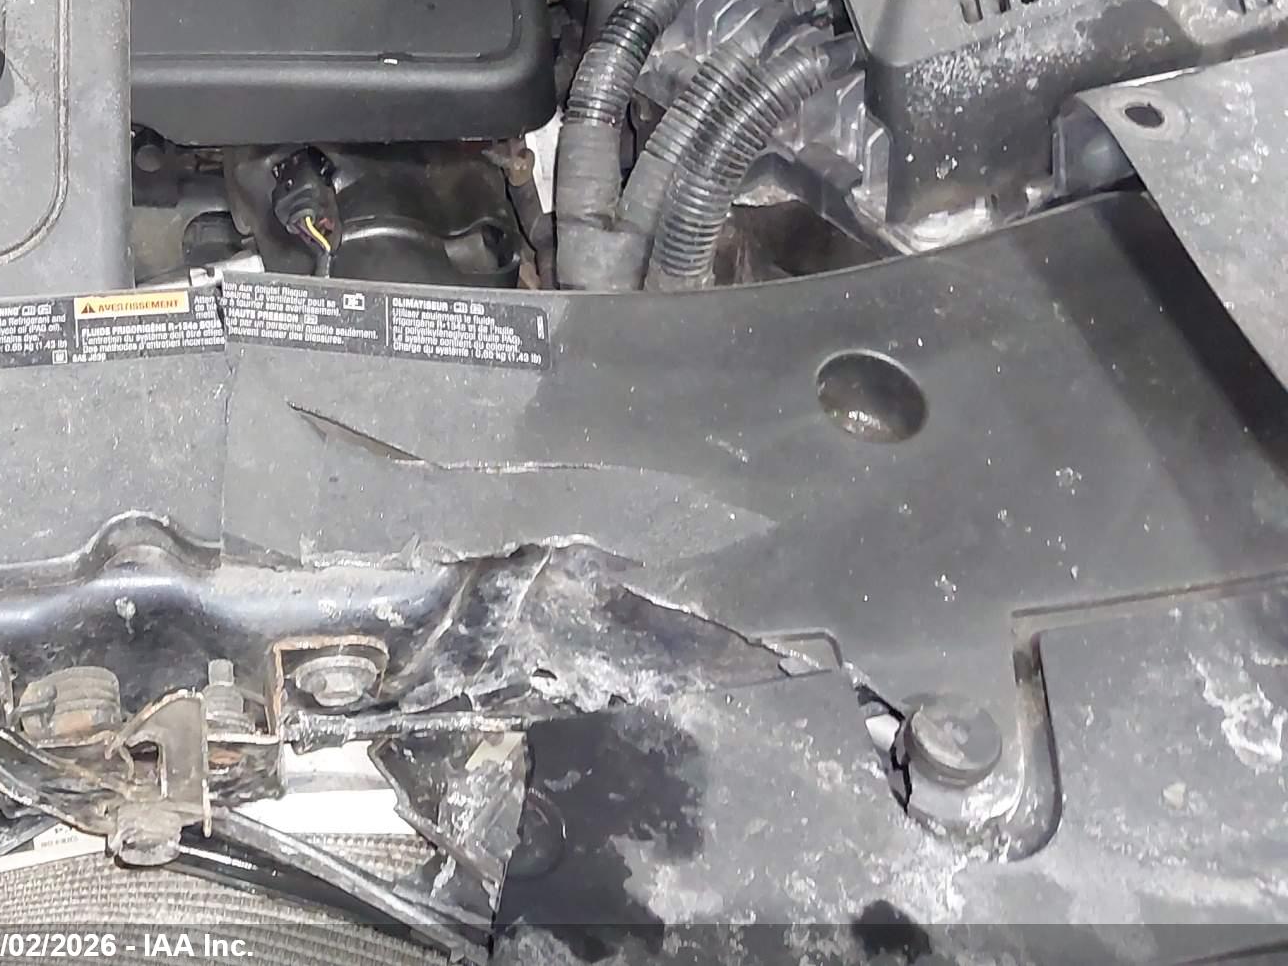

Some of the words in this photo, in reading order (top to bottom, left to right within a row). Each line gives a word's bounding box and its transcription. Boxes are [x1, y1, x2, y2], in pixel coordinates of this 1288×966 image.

[282, 289, 308, 299] Risque
[98, 299, 178, 313] AVERTISSEMENT
[236, 300, 264, 309] tourner
[265, 303, 284, 311] sans
[266, 295, 306, 305] ventilateur
[307, 298, 325, 308] peut
[392, 298, 448, 312] CLIMATISEUR
[8, 315, 50, 328] Refrigerant
[51, 314, 66, 323] and
[229, 308, 256, 319] HAUTE
[257, 311, 299, 323] PRESSION
[422, 311, 462, 323] seulement
[473, 316, 495, 326] fluide
[82, 327, 111, 338] FLUIDE
[240, 321, 253, 329] par
[266, 322, 303, 334] personnel
[289, 332, 303, 341] des
[393, 341, 421, 354] Charge
[440, 338, 472, 349] contient
